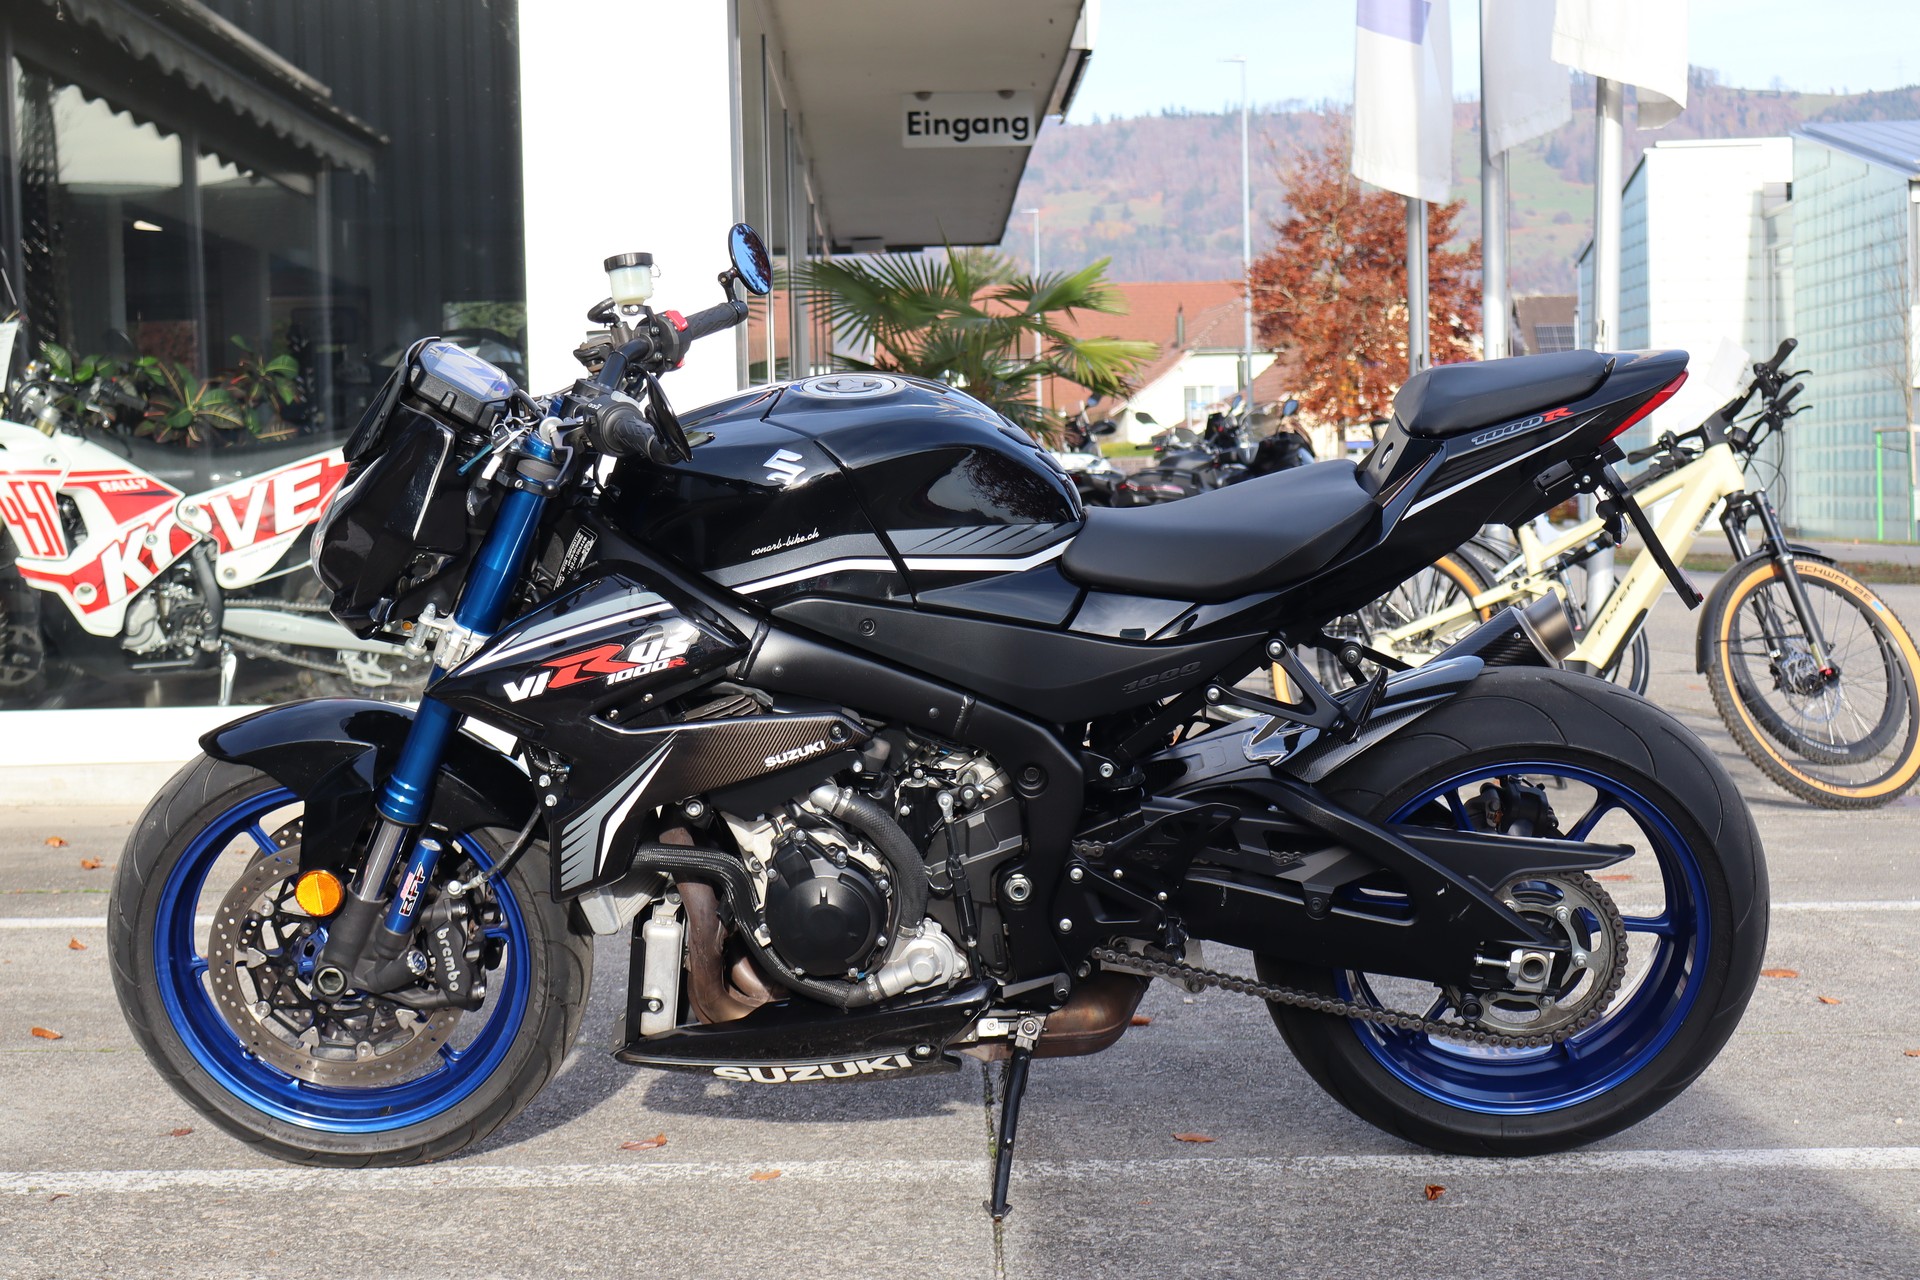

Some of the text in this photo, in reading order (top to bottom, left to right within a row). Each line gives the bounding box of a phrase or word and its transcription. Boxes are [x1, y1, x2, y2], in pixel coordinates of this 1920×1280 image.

[907, 111, 1028, 142] Eingang
[1471, 407, 1575, 446] 1000R
[98, 478, 149, 493] RALLY
[101, 462, 323, 605] KOVE
[1795, 564, 1873, 602] SCHWALBE
[606, 657, 690, 687] 1000R
[1122, 661, 1201, 694] 1000
[764, 739, 827, 768] SUZUKI
[436, 927, 461, 992] brembo
[713, 1054, 913, 1084] SUZUKI
